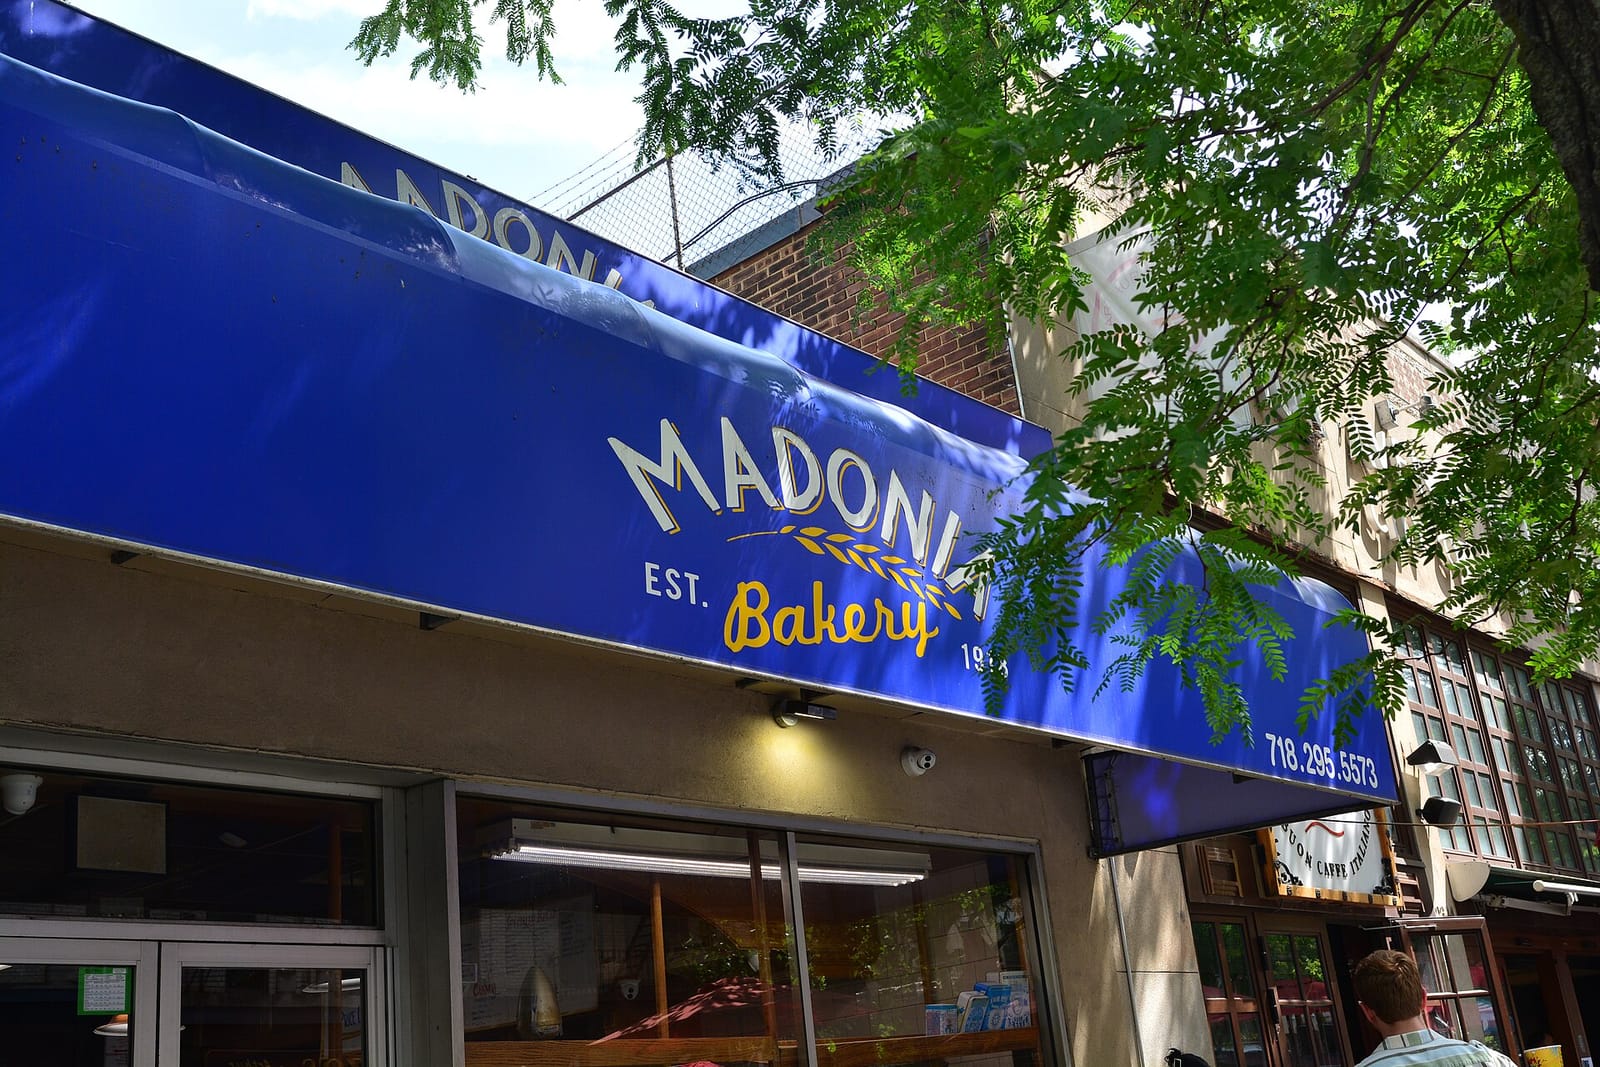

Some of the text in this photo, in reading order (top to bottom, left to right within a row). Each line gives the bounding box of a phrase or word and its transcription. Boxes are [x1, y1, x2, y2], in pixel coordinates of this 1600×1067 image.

[607, 416, 996, 623] MADONIA
[645, 561, 709, 608] EST.
[723, 580, 939, 658] Bakery
[961, 643, 1009, 679] 198
[1265, 733, 1379, 789] 718.295.5573
[1317, 861, 1348, 879] CAFFE
[1350, 809, 1372, 875] ITALIANO
